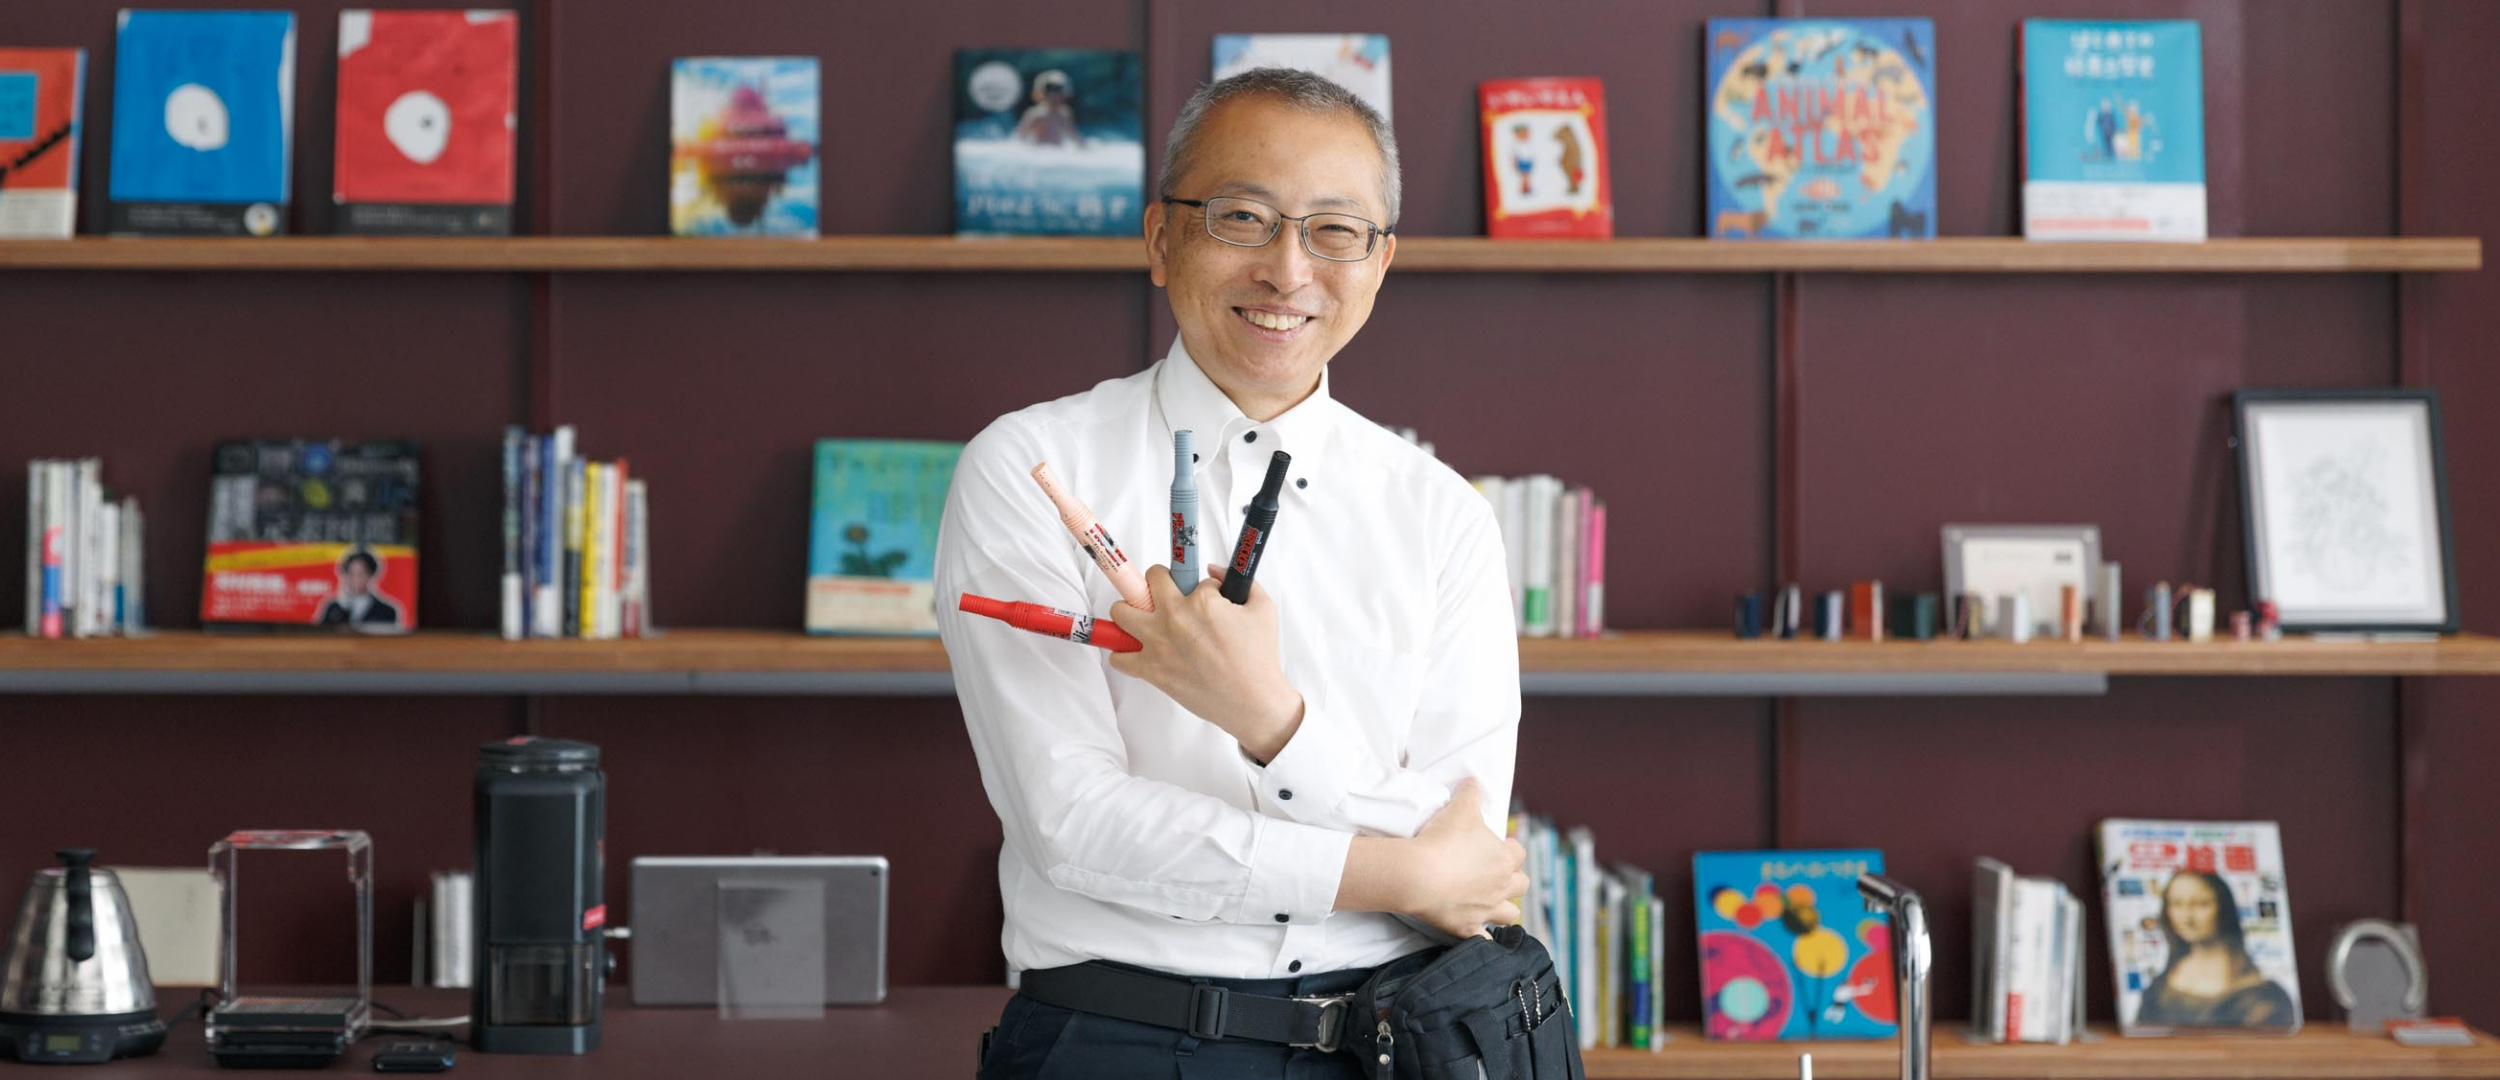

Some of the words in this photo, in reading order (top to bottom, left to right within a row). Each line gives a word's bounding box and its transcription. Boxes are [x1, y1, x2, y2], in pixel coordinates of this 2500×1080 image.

[1752, 85, 1892, 124] ANIMAL
[1767, 126, 1884, 164] ATLAS
[1233, 525, 1259, 576] PROCKEY
